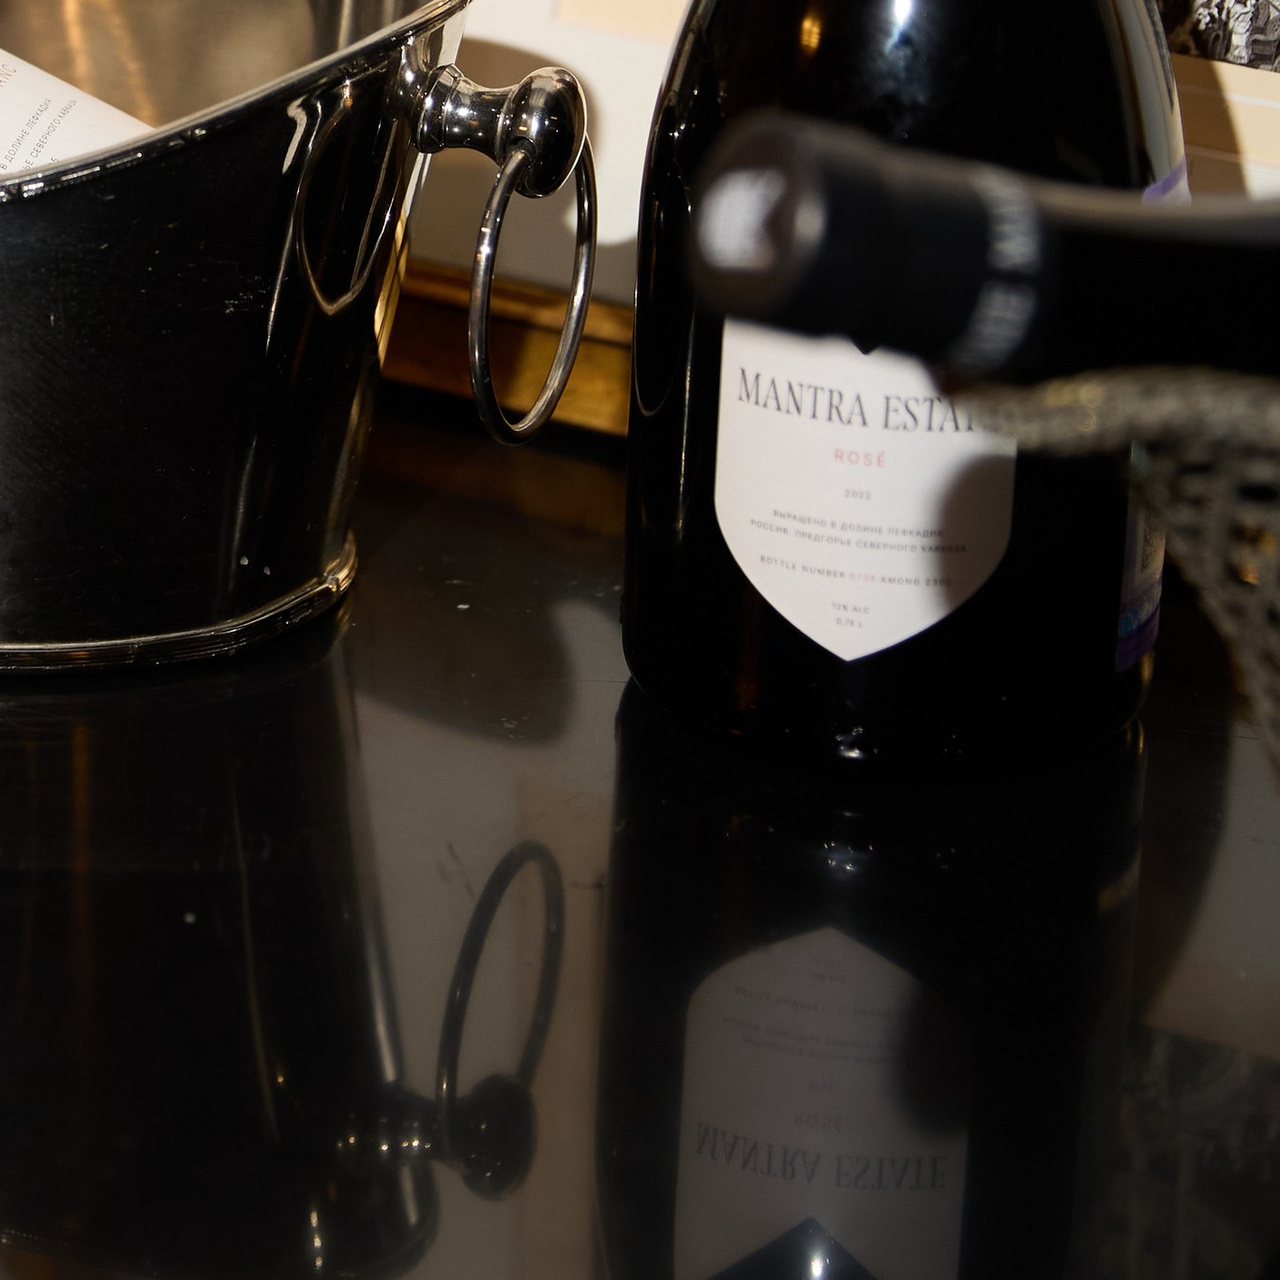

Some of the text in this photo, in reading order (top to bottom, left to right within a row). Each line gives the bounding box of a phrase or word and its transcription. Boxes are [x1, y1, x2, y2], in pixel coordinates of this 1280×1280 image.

[4, 128, 30, 163] ДОЛИНЕ
[30, 117, 61, 159] СЕВЕРНОГО
[737, 367, 974, 434] MANTRA ESTA
[834, 446, 887, 468] ROSÉ
[760, 554, 797, 571] BOTTLE
[802, 564, 847, 579] NUMBER
[880, 575, 921, 587] AMONG
